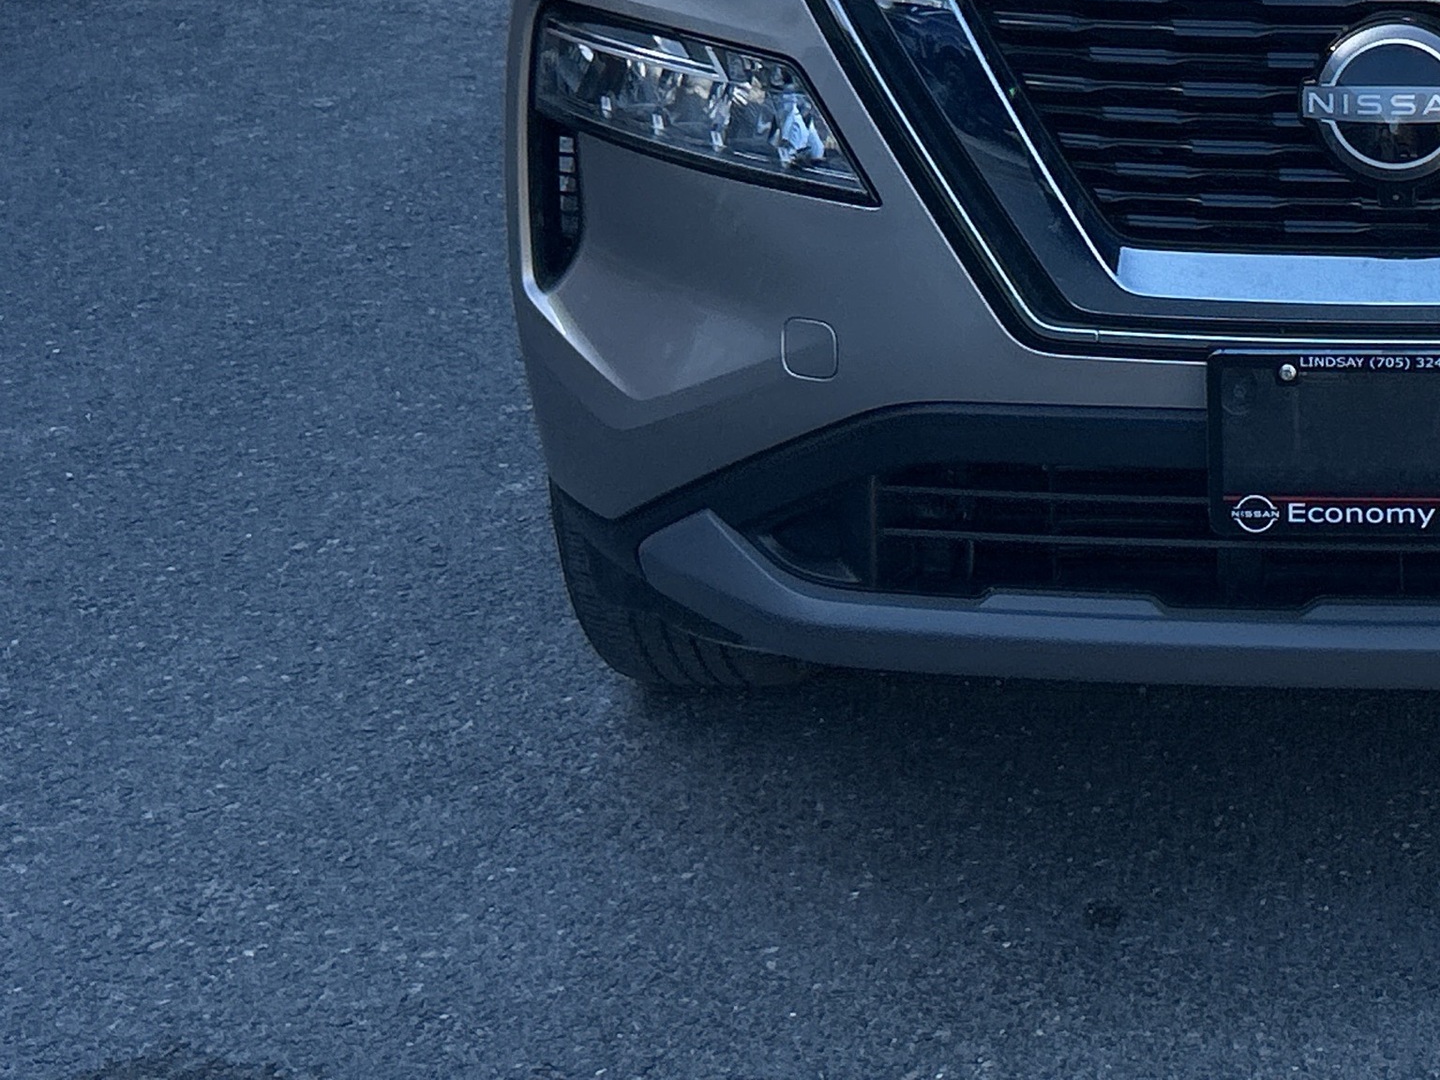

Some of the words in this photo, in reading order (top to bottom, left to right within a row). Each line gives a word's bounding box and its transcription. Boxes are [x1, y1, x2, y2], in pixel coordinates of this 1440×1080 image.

[1300, 356, 1364, 368] LINDSAY
[1369, 356, 1410, 370] (705)
[1231, 510, 1280, 519] NISSAN
[1288, 502, 1436, 529] Economy
